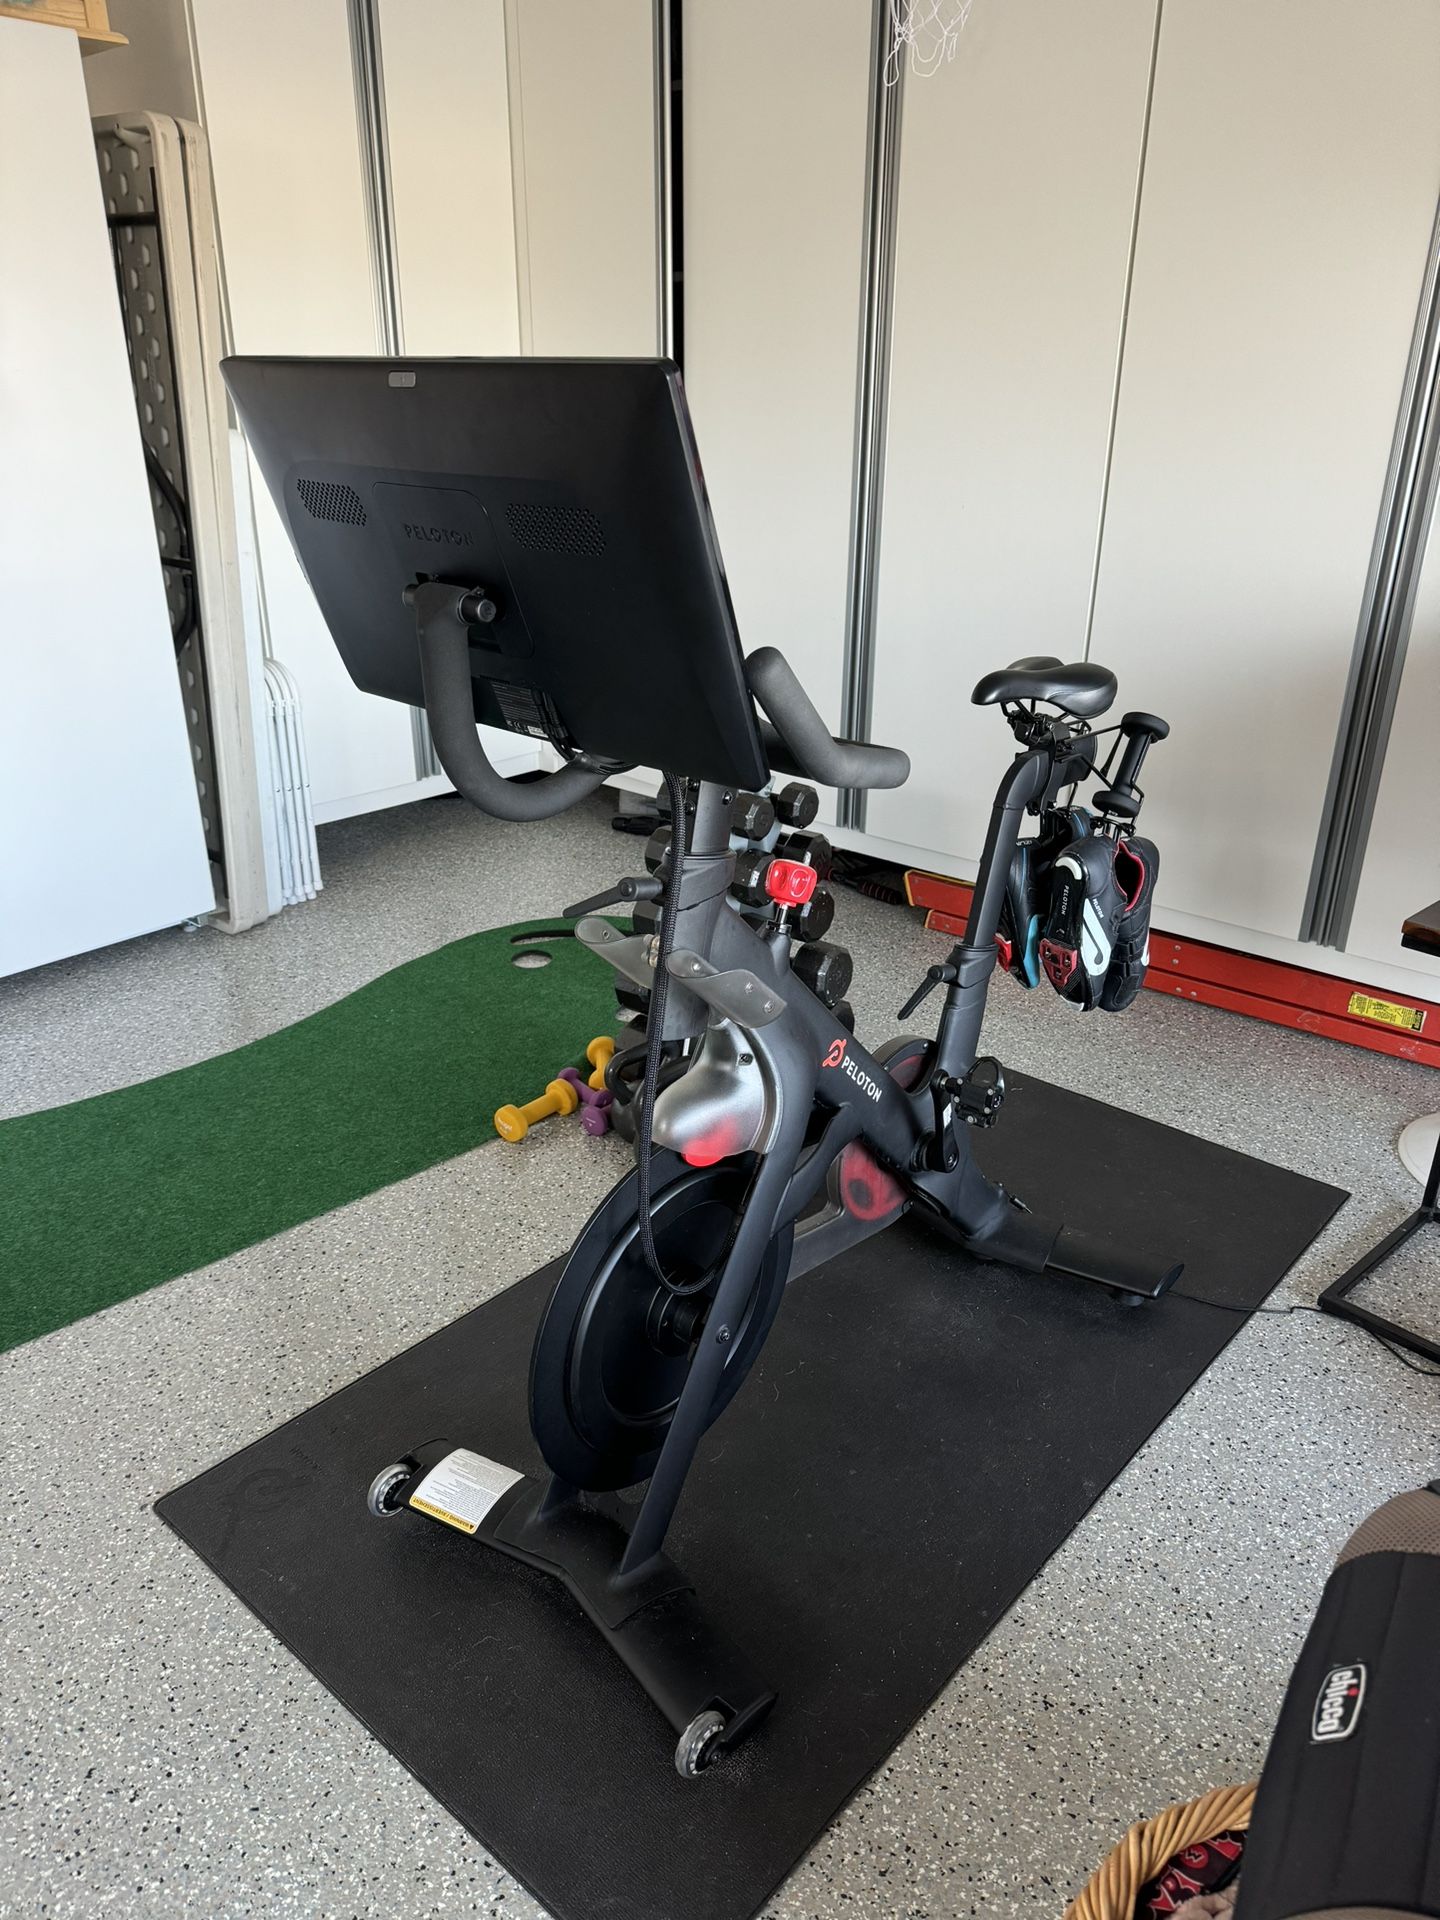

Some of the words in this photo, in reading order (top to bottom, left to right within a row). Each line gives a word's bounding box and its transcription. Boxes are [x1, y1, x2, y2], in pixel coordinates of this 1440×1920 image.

[403, 524, 474, 546] PELOTON
[1061, 884, 1070, 916] PELOTON
[841, 1055, 883, 1102] PELOTON
[1317, 1670, 1360, 1734] chicco
